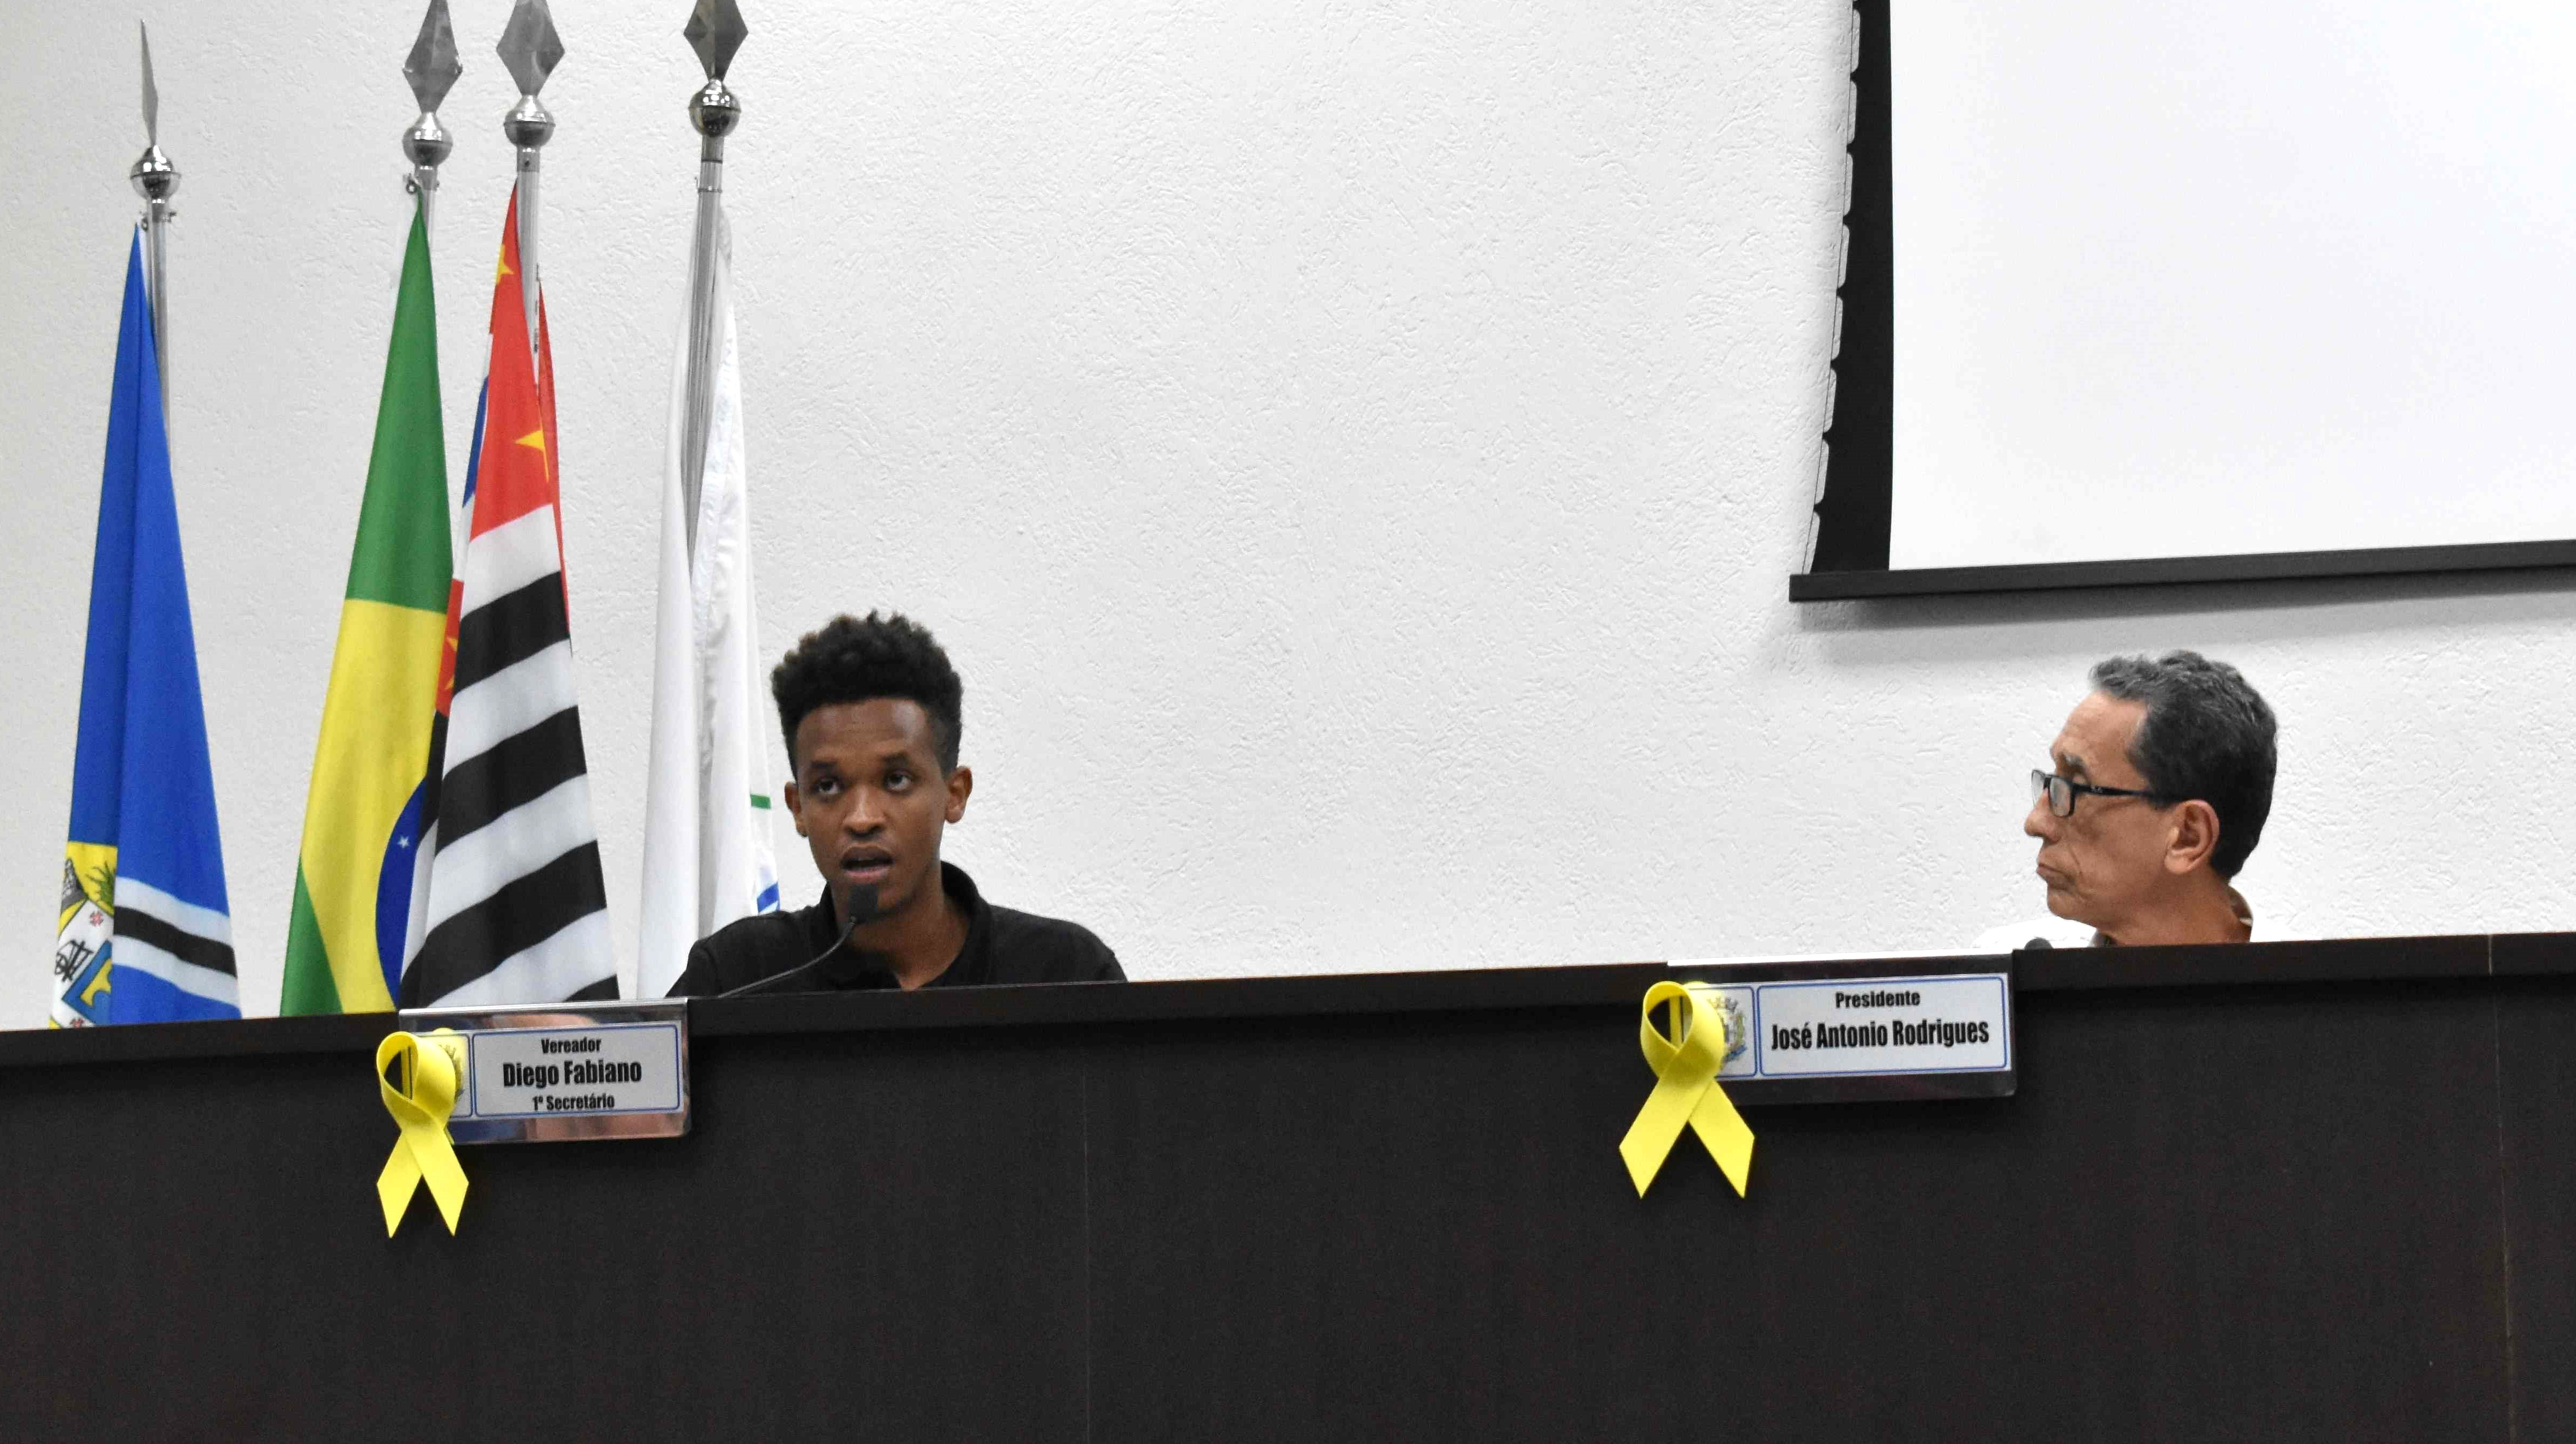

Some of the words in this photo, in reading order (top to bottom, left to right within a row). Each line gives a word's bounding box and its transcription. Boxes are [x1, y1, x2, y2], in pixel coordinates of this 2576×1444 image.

[1835, 991, 1921, 1008] Presidente
[1771, 1022, 1812, 1051] José
[1816, 1021, 1889, 1049] Antonio
[1893, 1018, 1990, 1047] Rodrigues
[541, 1037, 602, 1054] Vereador
[503, 1062, 559, 1089] Diego
[564, 1059, 642, 1084] Fabiano
[546, 1093, 615, 1110] Secretário
